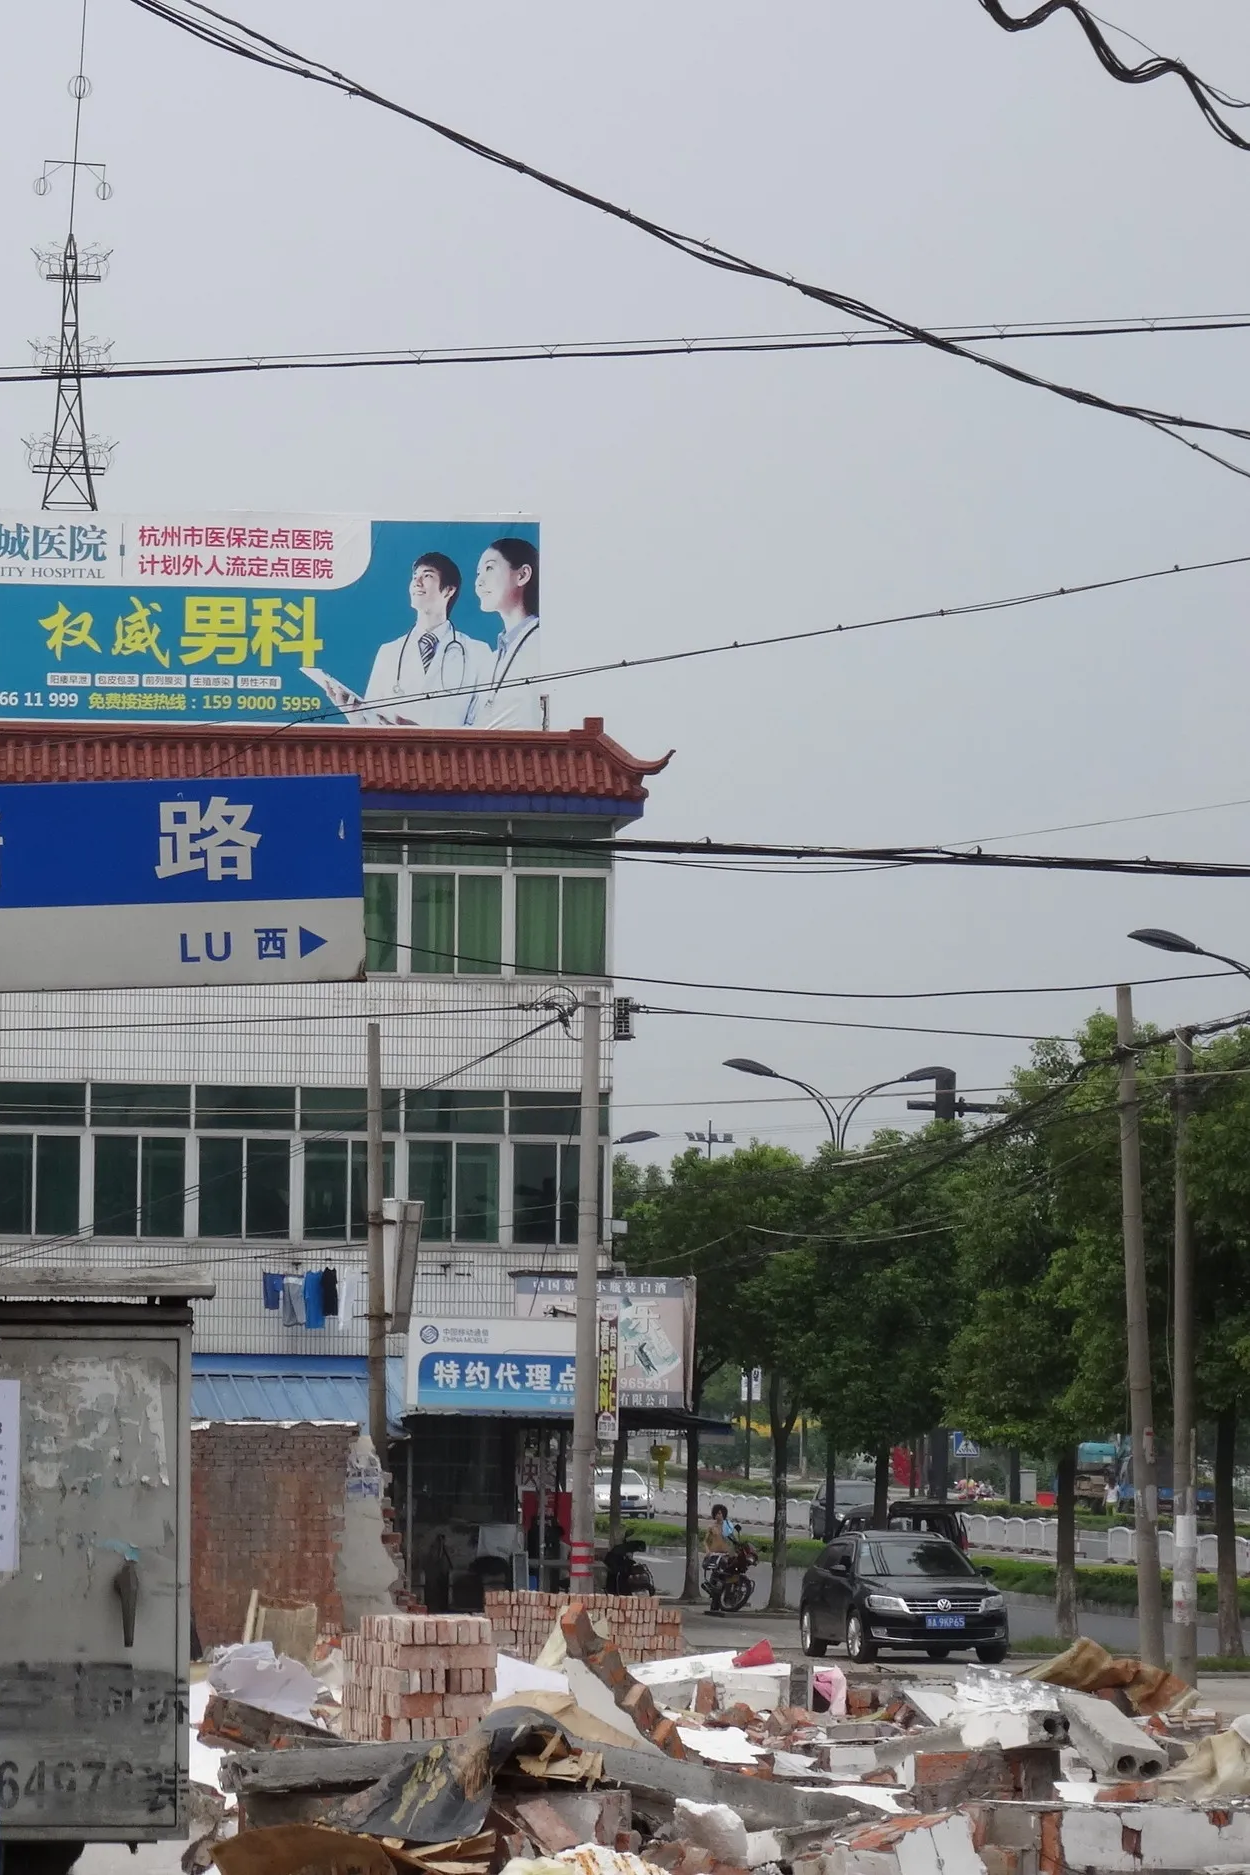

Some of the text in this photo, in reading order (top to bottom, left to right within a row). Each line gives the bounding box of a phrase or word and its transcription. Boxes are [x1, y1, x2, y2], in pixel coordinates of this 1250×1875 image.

[138, 525, 334, 551] 杭州市医保定点医院
[32, 566, 105, 579] HOSPITAL
[138, 555, 334, 580] 计划外人流定点医院
[237, 695, 277, 710] 9000
[179, 931, 232, 963] LU
[257, 928, 288, 961] 西
[434, 1360, 576, 1392] 特约代理点
